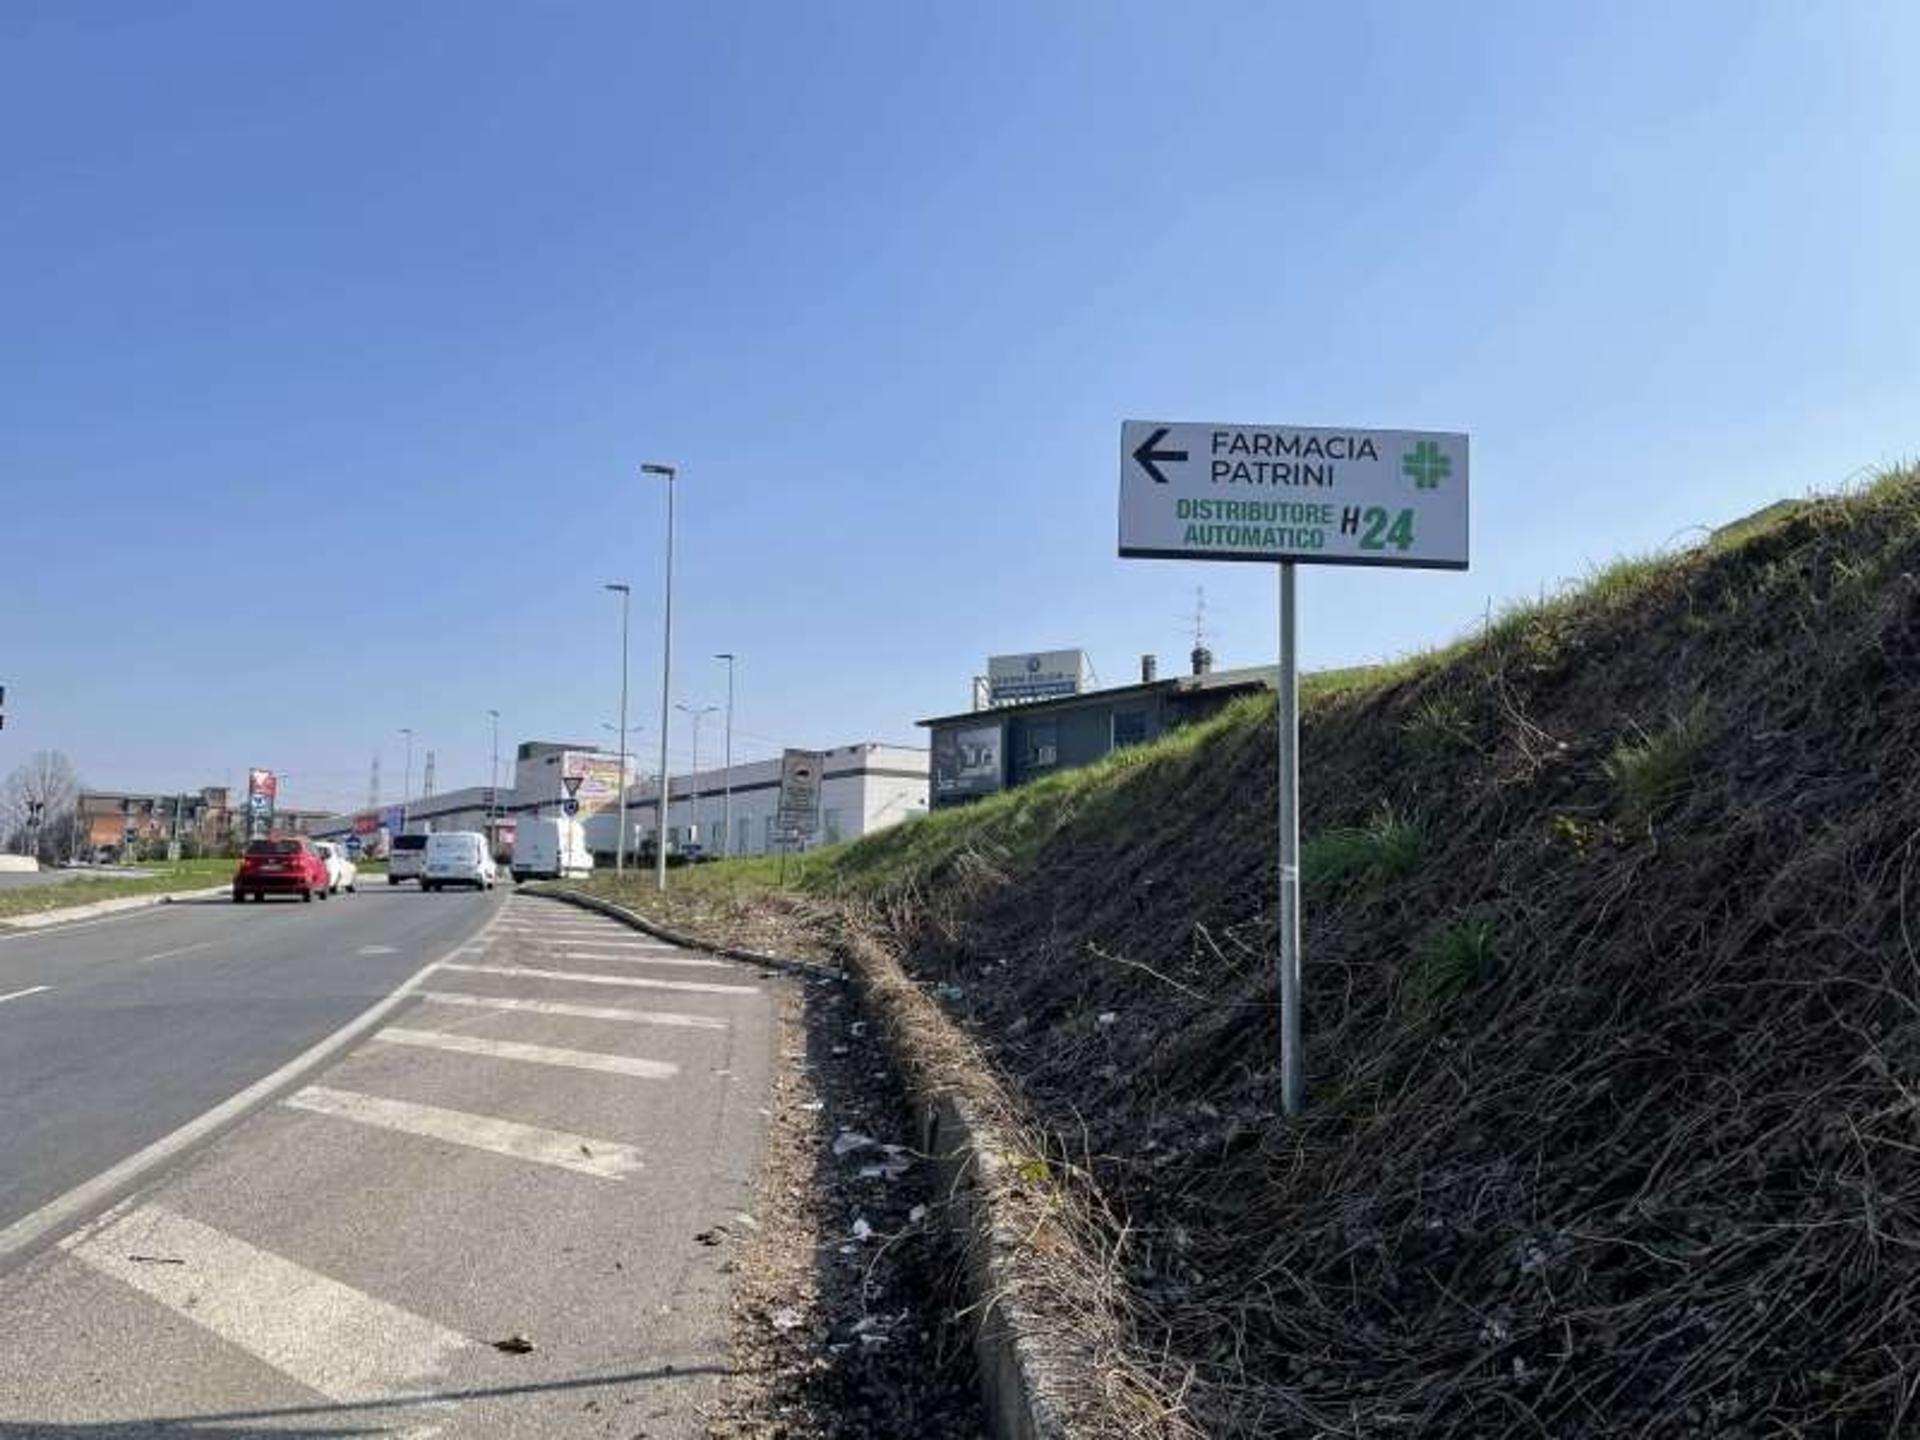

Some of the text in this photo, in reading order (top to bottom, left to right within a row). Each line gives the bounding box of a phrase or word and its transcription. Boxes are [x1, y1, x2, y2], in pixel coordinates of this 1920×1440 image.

[1211, 431, 1379, 462] FARMACIA
[1211, 460, 1334, 487] PATRINI
[1177, 498, 1335, 524] DISTRIBUTORE
[1185, 525, 1325, 549] AUTOMATICO
